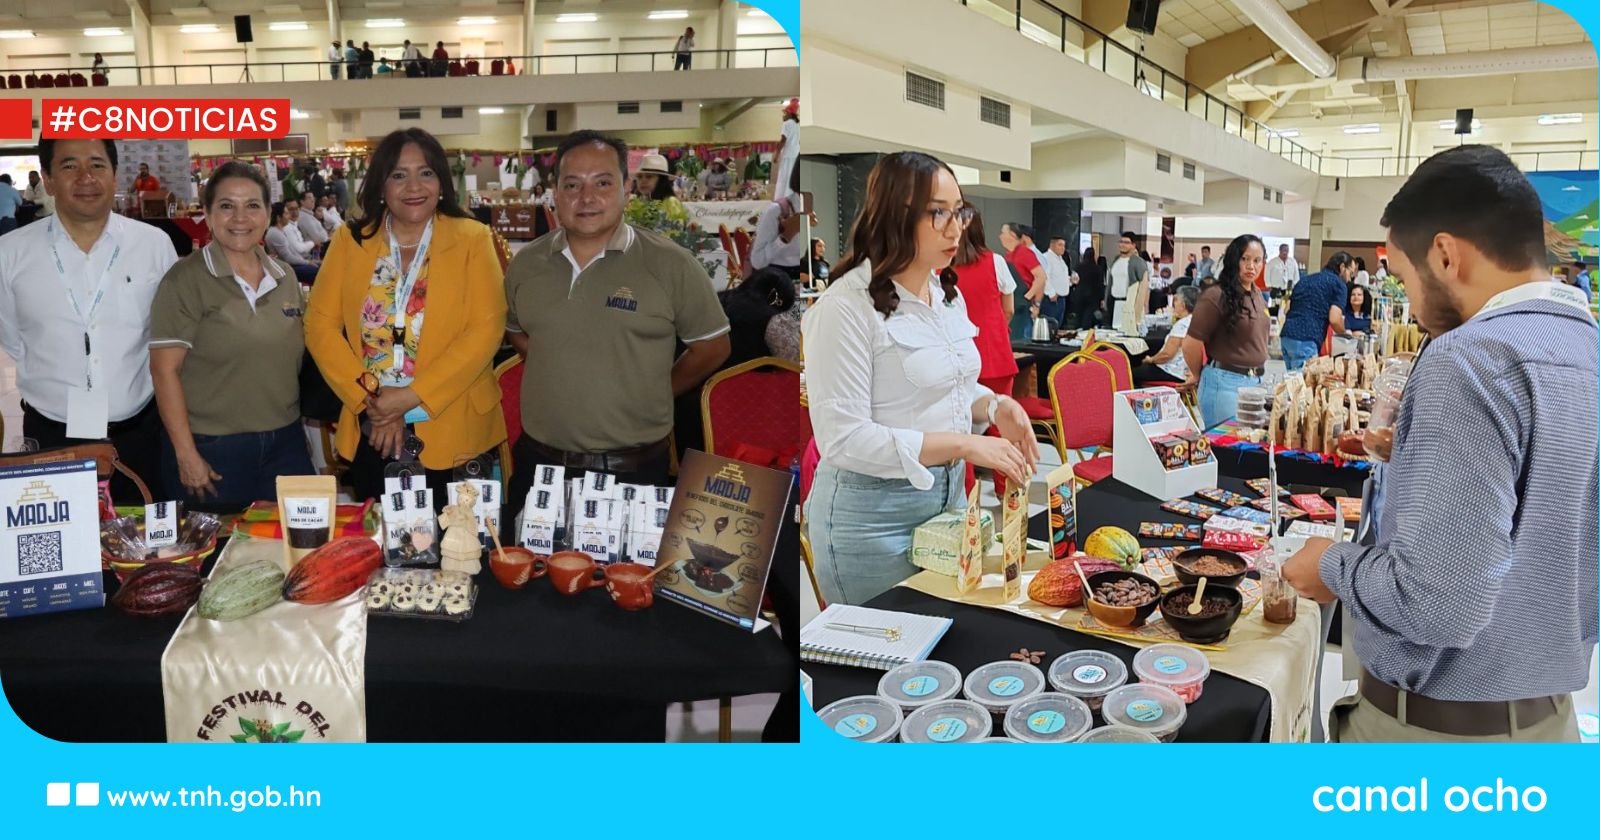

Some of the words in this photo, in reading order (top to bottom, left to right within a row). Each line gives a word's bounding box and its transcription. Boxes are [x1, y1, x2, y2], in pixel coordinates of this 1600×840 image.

[703, 475, 752, 504] MADJA
[7, 502, 70, 527] MADJA
[150, 529, 173, 540] MADJA
[527, 537, 551, 549] MADJA
[581, 543, 607, 555] MADJA
[196, 689, 287, 740] FESTIVAL
[295, 700, 331, 738] DEL
